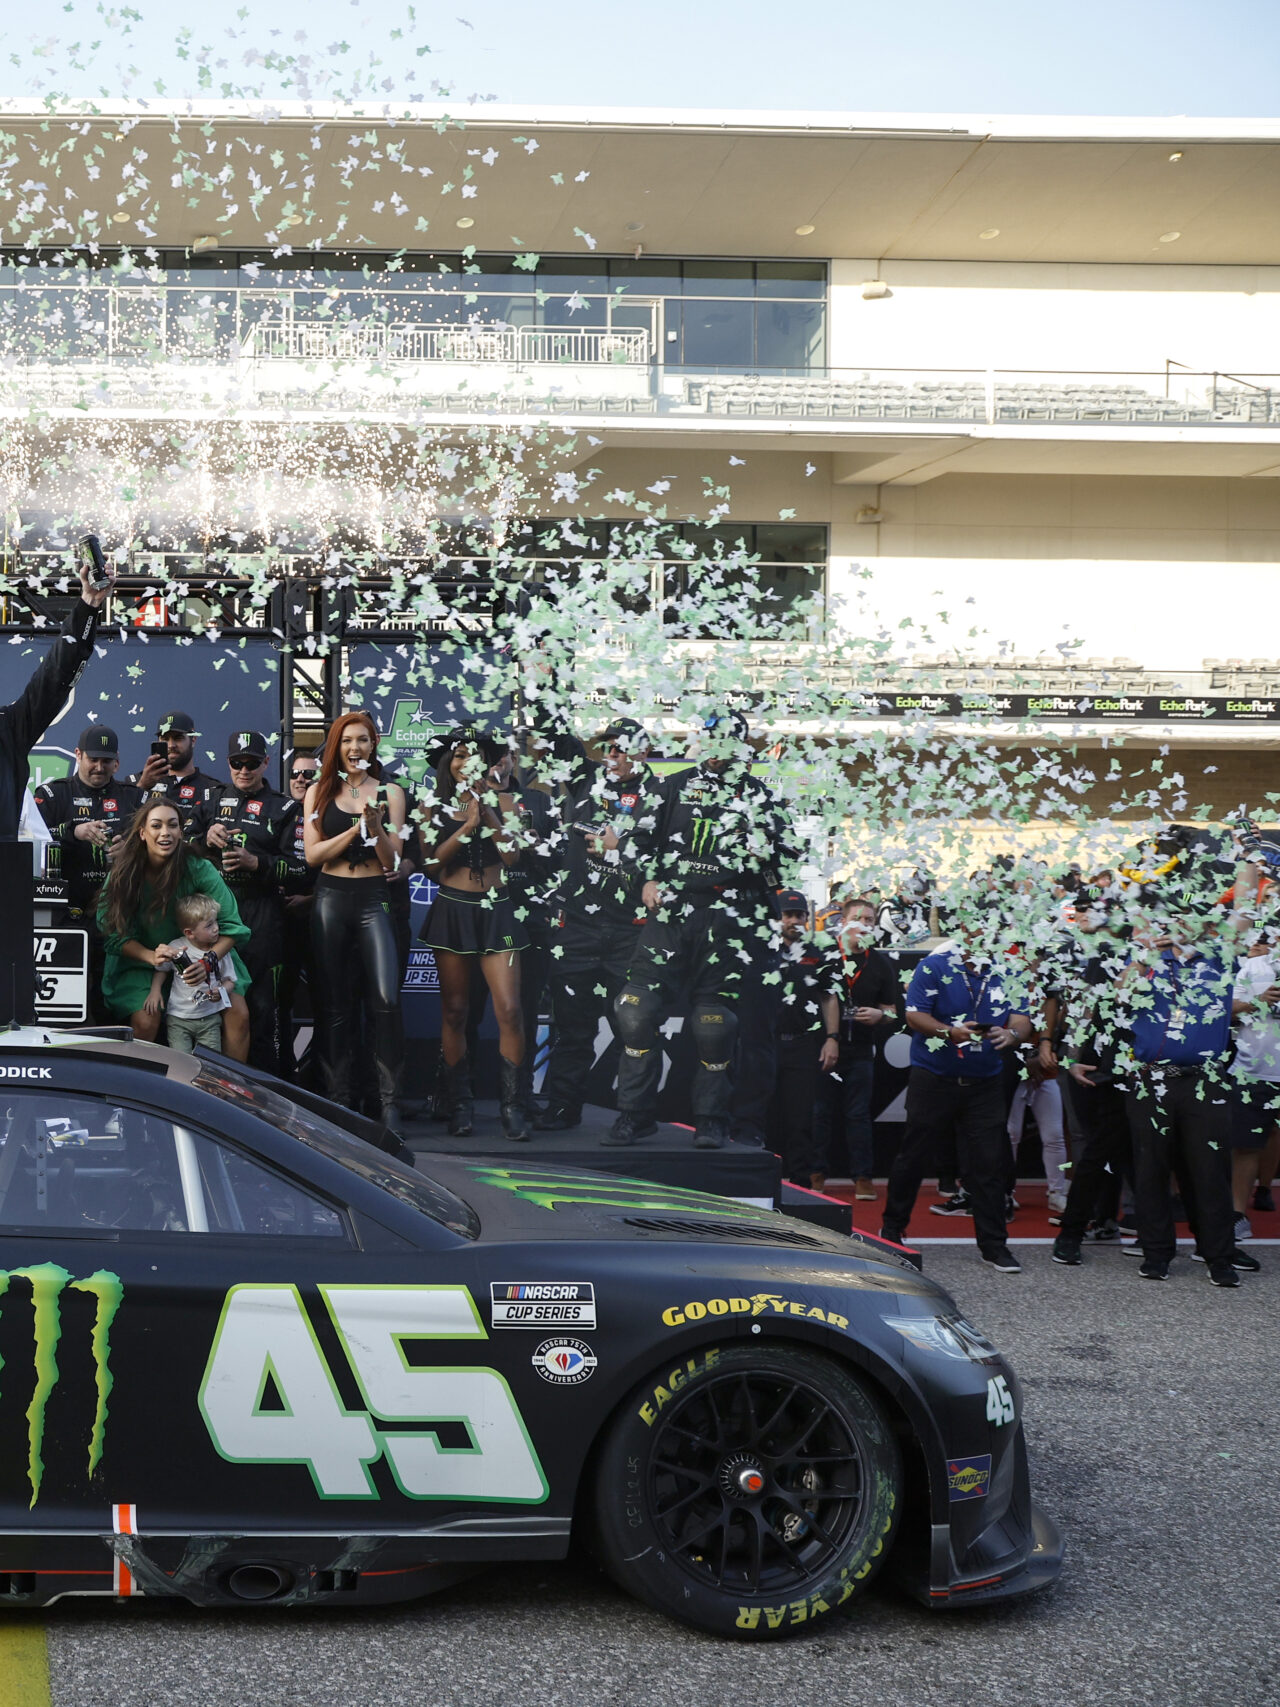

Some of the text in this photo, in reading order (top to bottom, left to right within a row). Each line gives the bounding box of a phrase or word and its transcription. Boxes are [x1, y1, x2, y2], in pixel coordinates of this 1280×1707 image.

[1094, 698, 1144, 710] EchoPark
[1159, 699, 1209, 711] EchoPark
[1226, 700, 1276, 712] EchoPark
[35, 885, 64, 895] xfinity
[523, 1286, 579, 1299] NASCAR
[506, 1306, 581, 1319] CUP SERIES
[540, 1339, 588, 1354] NASCAR 75TH
[539, 1366, 591, 1383] ANNIVERSARY
[197, 1283, 550, 1504] 45
[986, 1375, 1015, 1427] 45
[948, 1472, 988, 1487] SUNOCO
